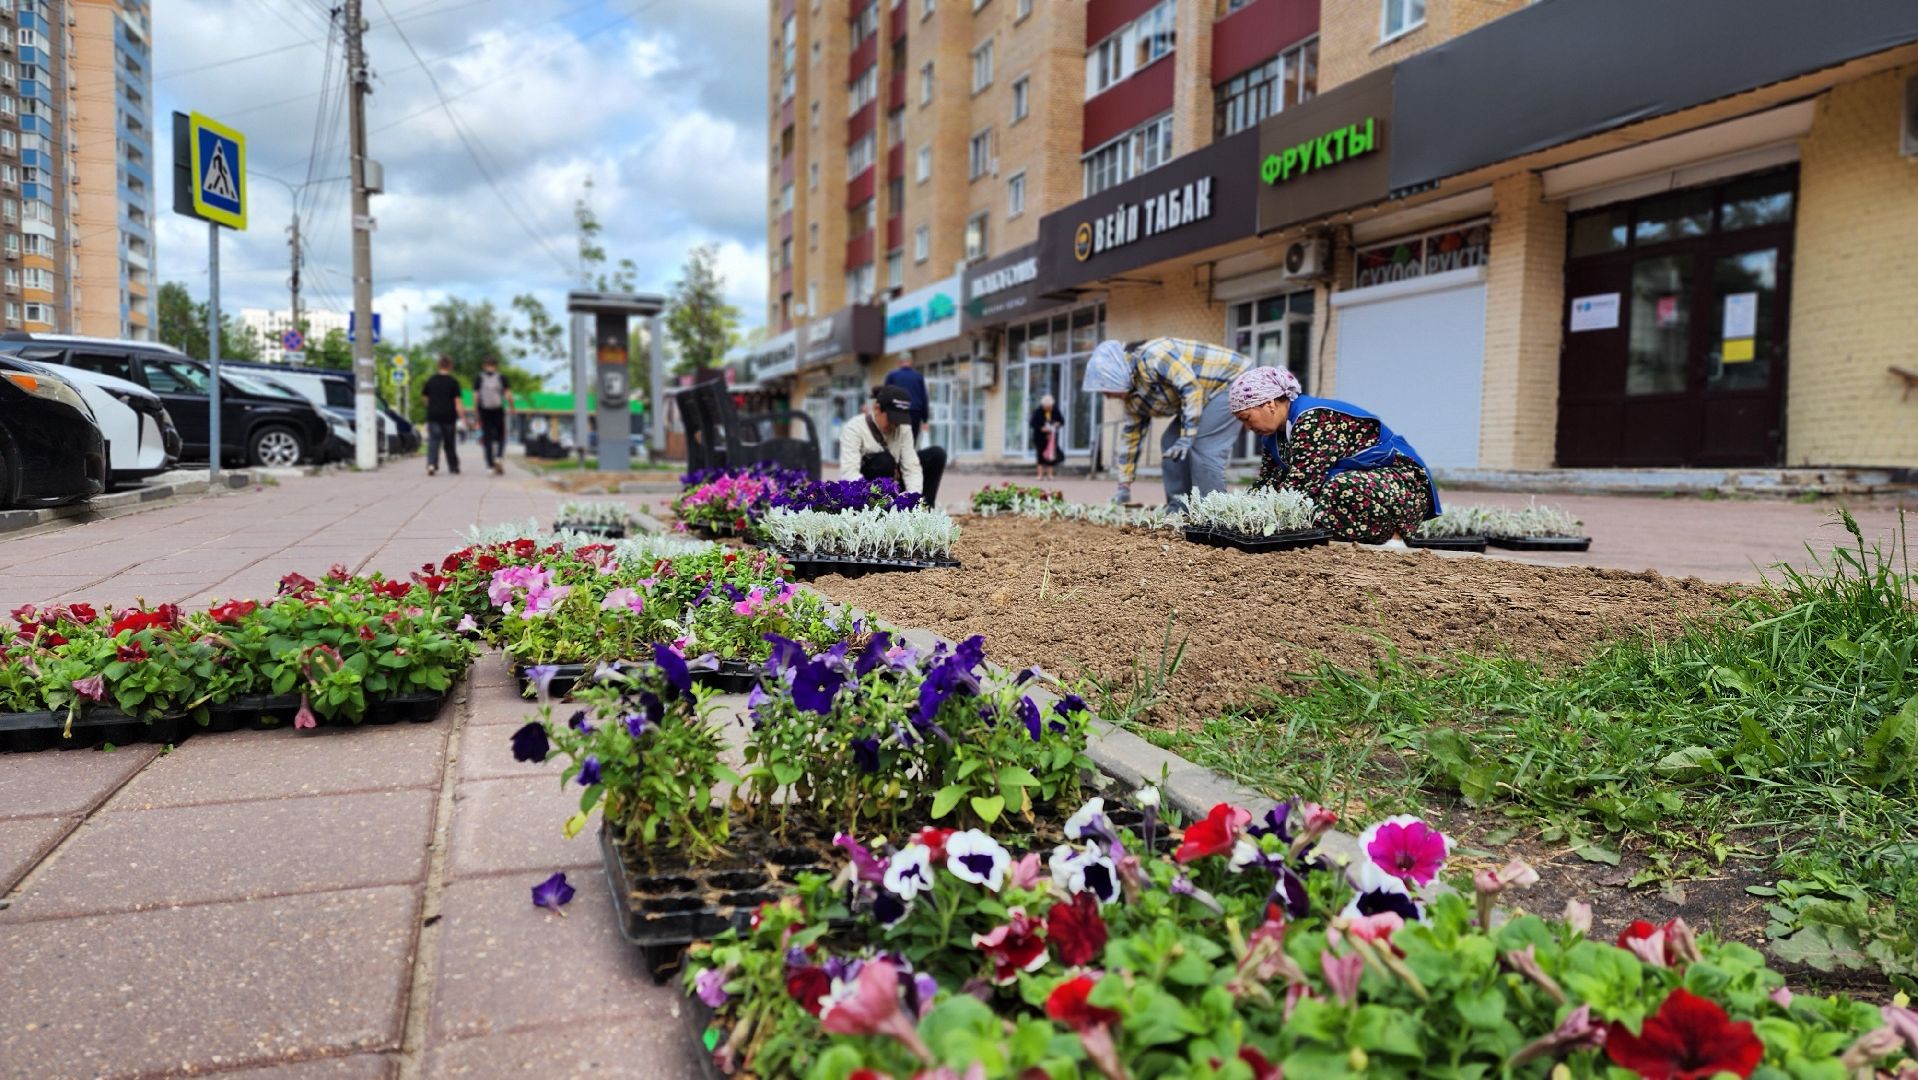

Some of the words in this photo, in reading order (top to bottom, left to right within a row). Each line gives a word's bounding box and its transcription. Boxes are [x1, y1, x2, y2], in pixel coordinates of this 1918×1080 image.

[1261, 117, 1374, 185] ФРУКТЫ
[1093, 203, 1139, 254] ВЕЙП
[1145, 176, 1211, 237] ТАБАК
